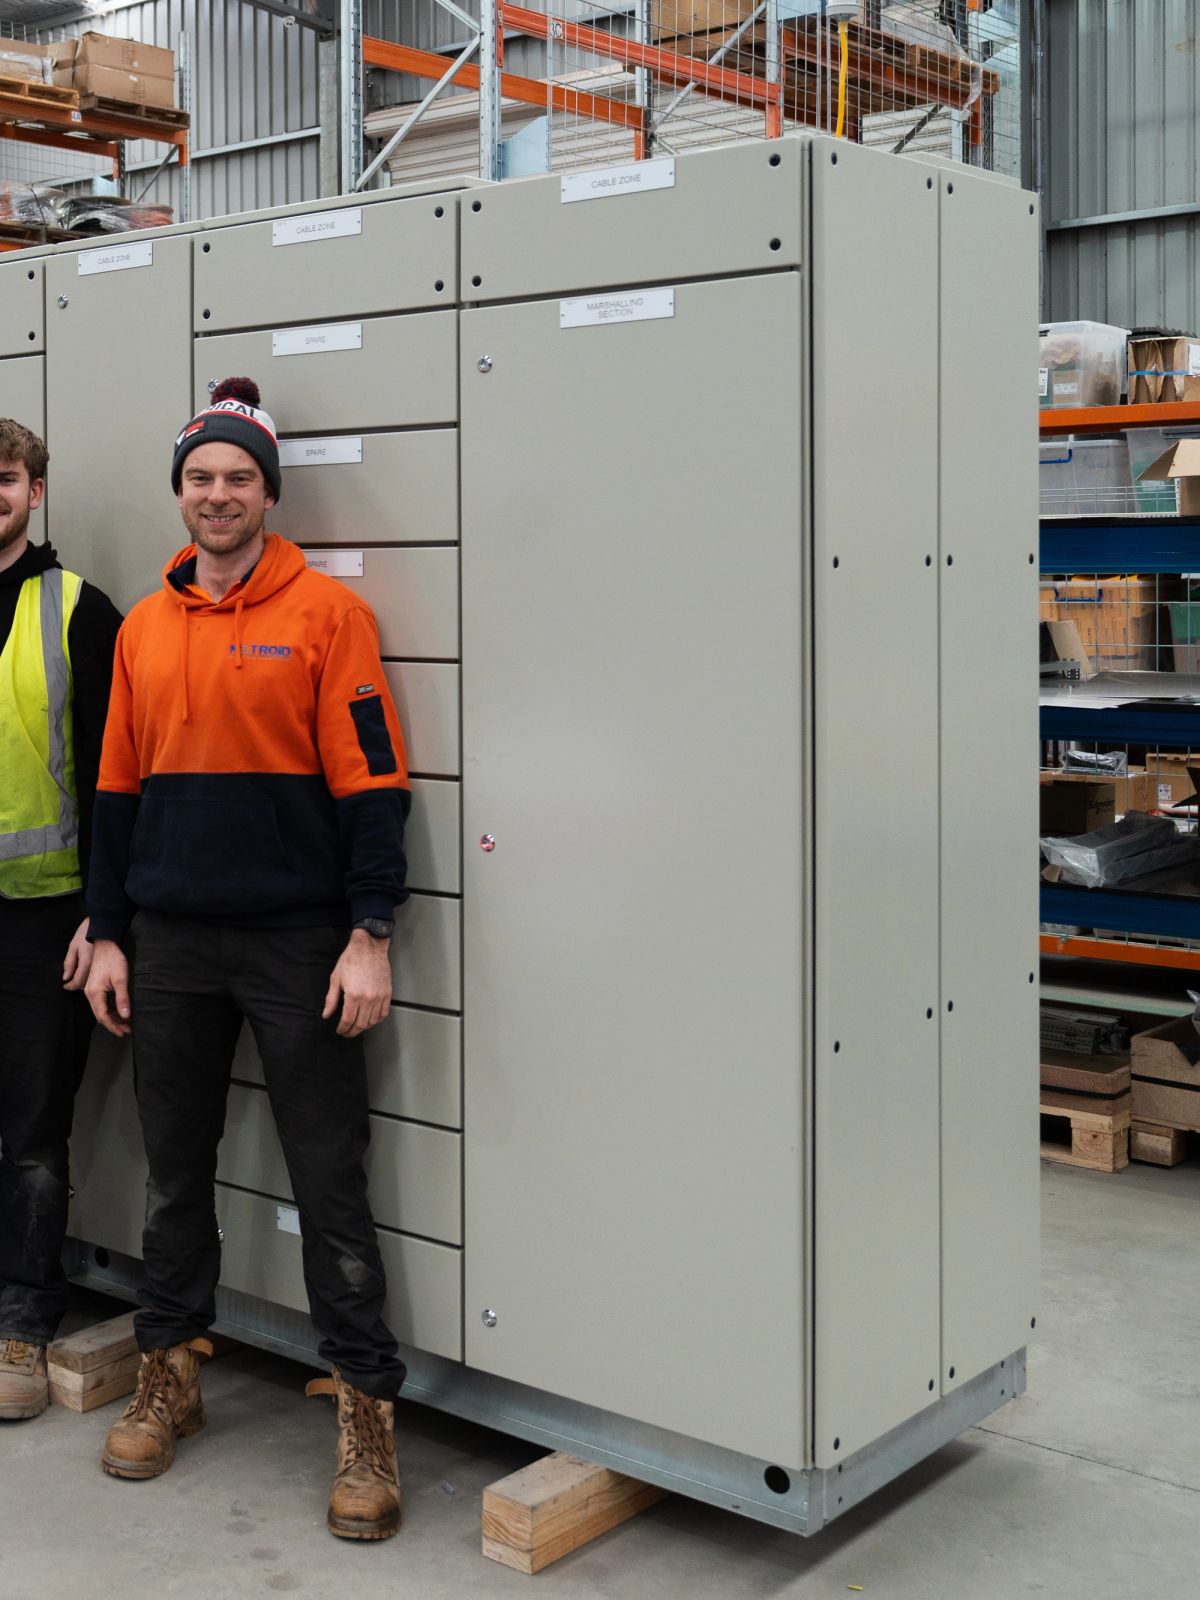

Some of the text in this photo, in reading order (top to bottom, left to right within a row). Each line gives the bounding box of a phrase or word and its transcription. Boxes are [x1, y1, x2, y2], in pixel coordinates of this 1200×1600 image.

[591, 177, 617, 188] CABLE
[619, 173, 641, 185] ZONE
[296, 222, 336, 234] CABLE ZONE
[98, 254, 131, 264] CABLE ZONE
[587, 298, 643, 310] MARSHALLING
[598, 308, 634, 318] SECTION
[305, 336, 326, 344] SPARE
[307, 560, 327, 568] SPARE
